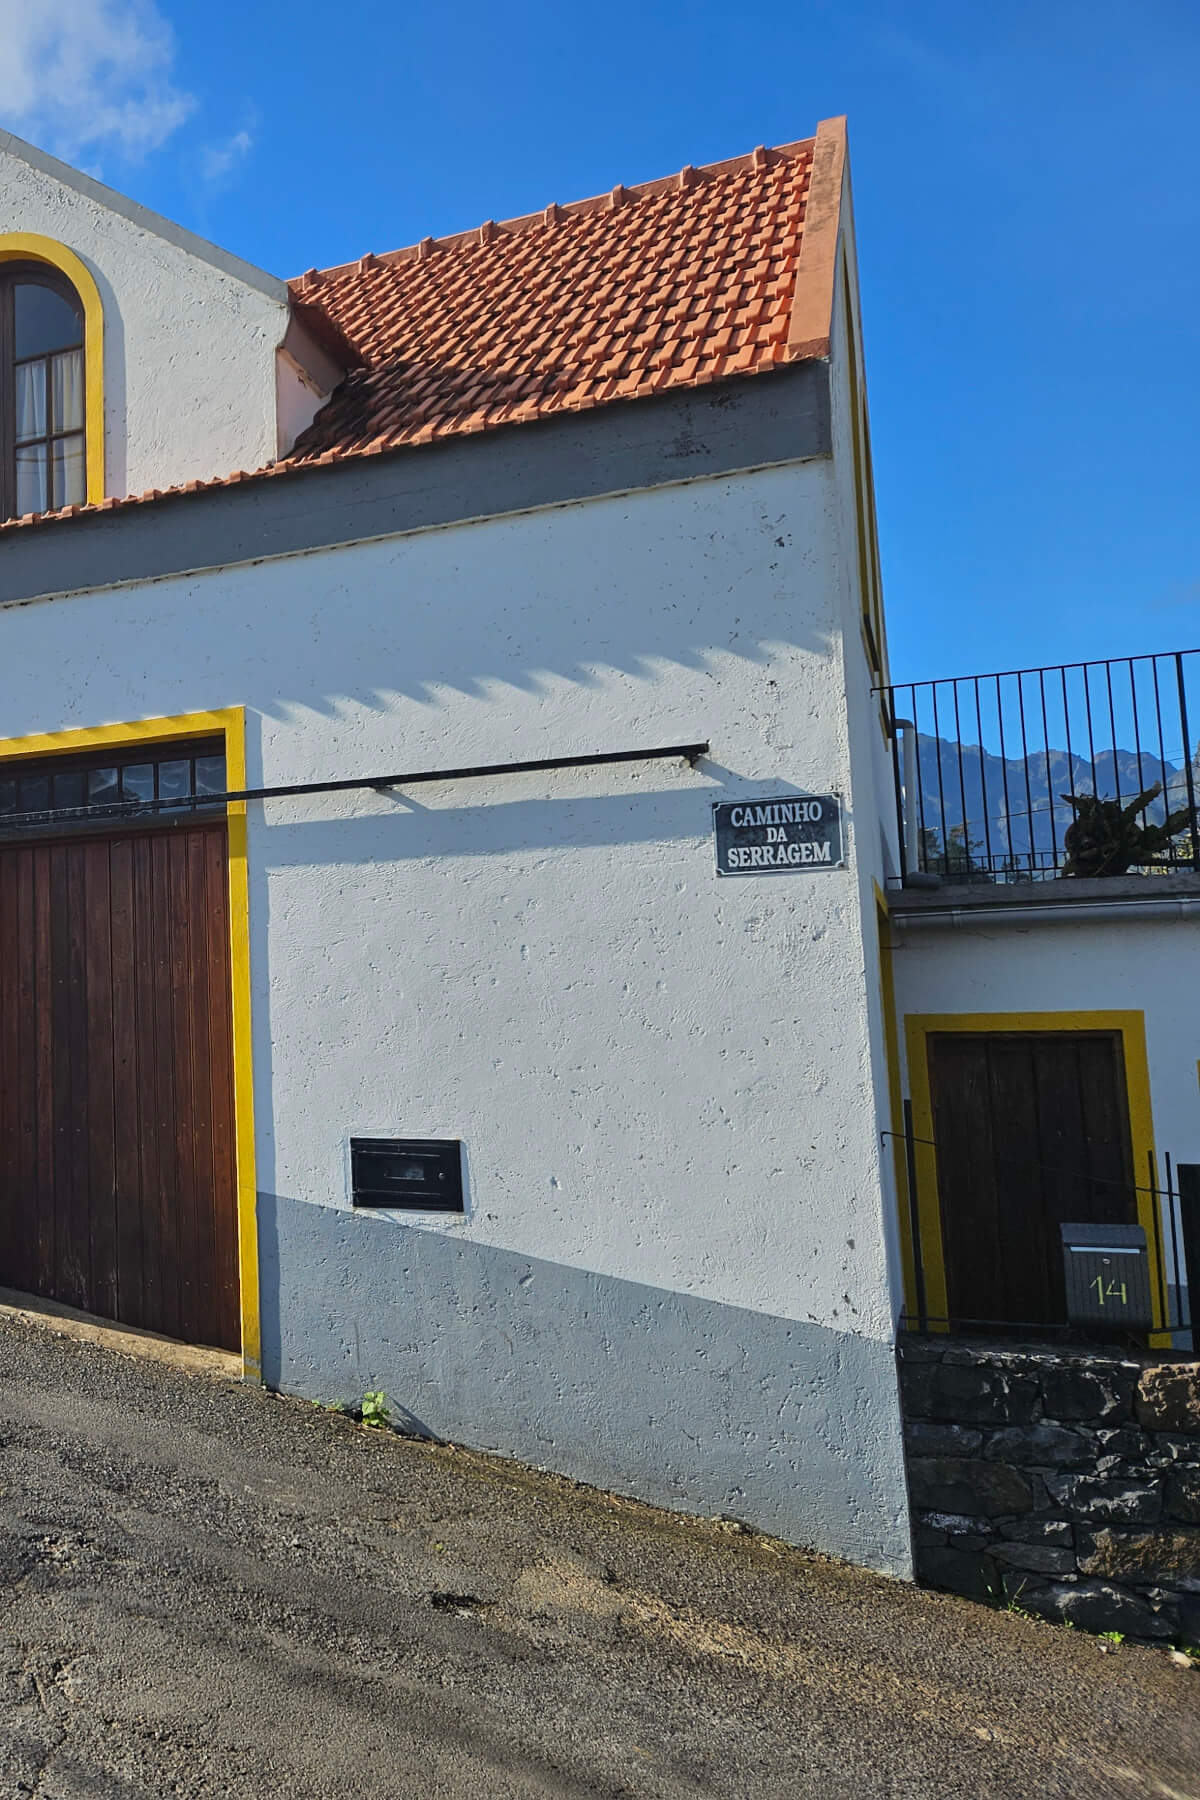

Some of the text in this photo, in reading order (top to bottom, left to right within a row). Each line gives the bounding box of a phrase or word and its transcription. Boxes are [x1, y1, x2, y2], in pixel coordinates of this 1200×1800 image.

[730, 801, 822, 827] CAMINHO
[766, 827, 788, 843] DA
[727, 841, 831, 868] SERRAGEM
[1089, 1275, 1127, 1305] 14
